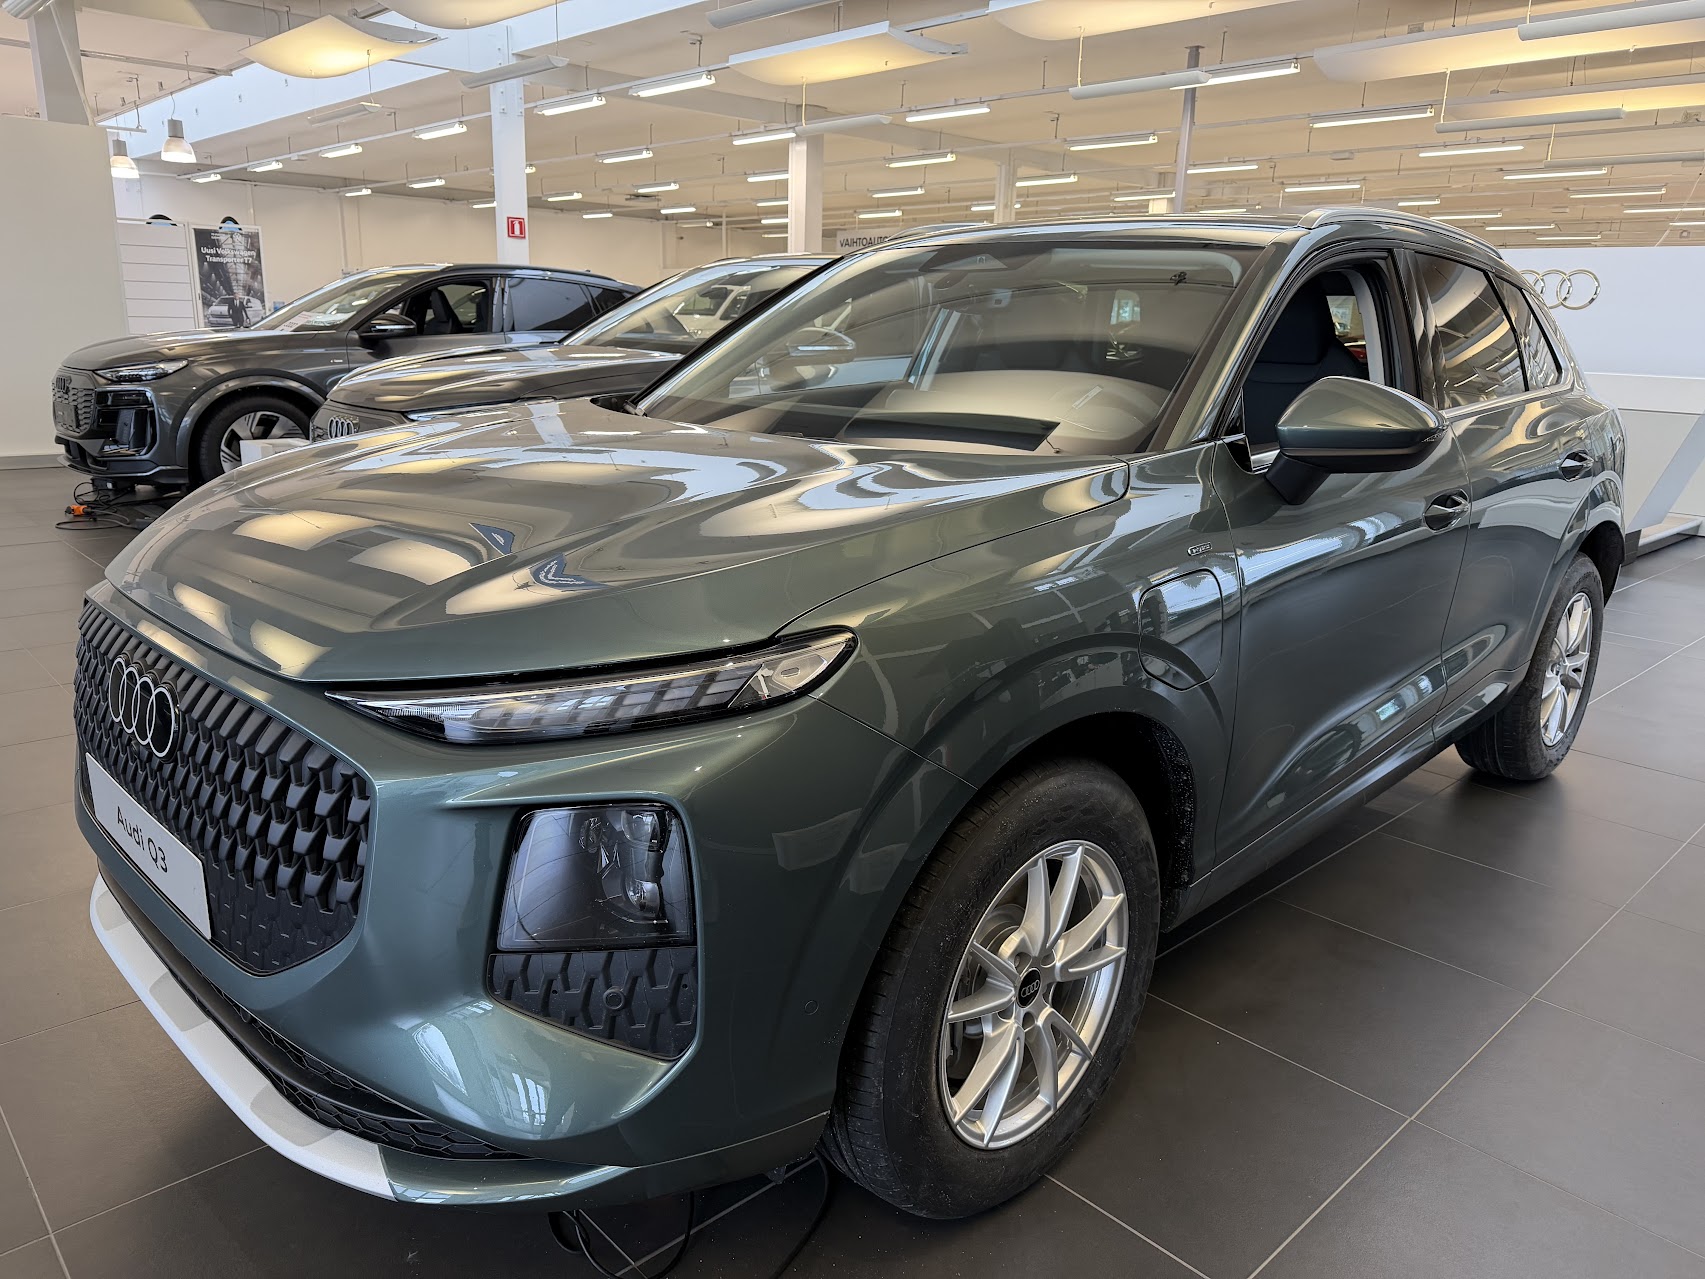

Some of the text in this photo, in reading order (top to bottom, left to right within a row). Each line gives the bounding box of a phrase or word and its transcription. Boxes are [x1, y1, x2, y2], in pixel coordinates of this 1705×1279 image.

[839, 235, 891, 247] VAIHTOAUTO
[201, 246, 255, 256] Uusi Volkswagen
[205, 255, 243, 263] Transporter
[117, 806, 168, 873] Audi Q3
